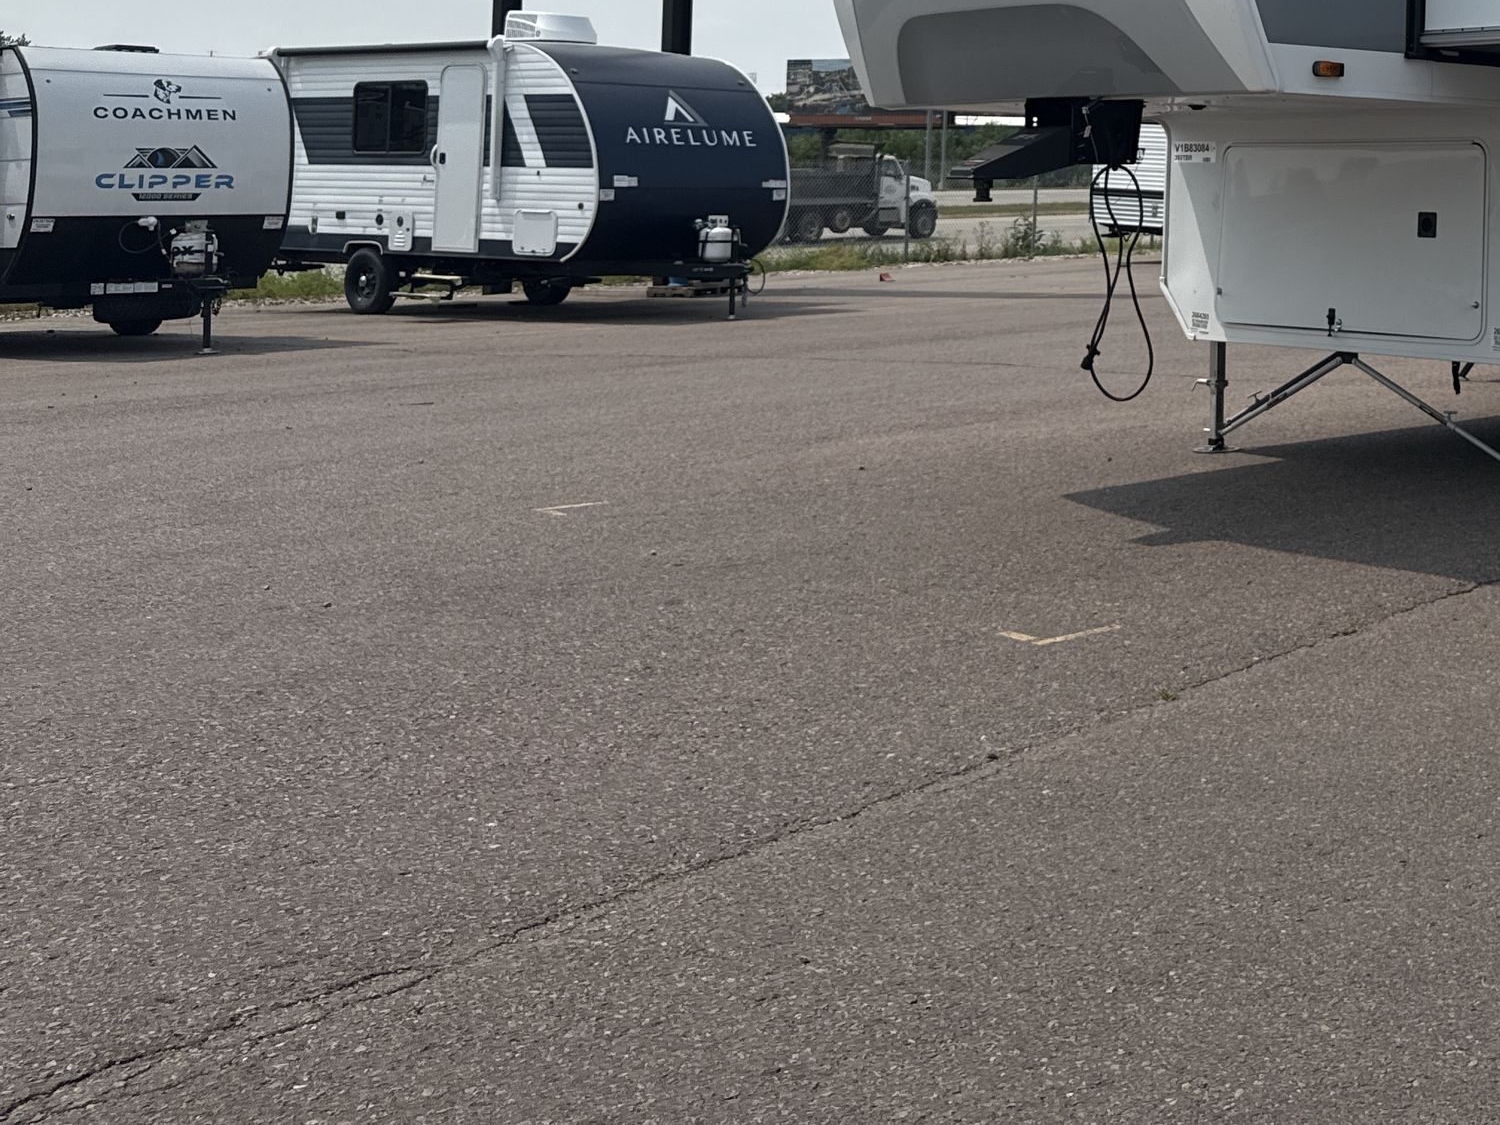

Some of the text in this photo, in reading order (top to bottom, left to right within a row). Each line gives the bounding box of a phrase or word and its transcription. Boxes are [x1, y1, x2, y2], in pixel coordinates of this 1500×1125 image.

[93, 106, 237, 121] COACHMEN
[626, 126, 757, 147] AIRELUME
[95, 173, 235, 190] CLIPPER
[162, 192, 193, 201] SERIES
